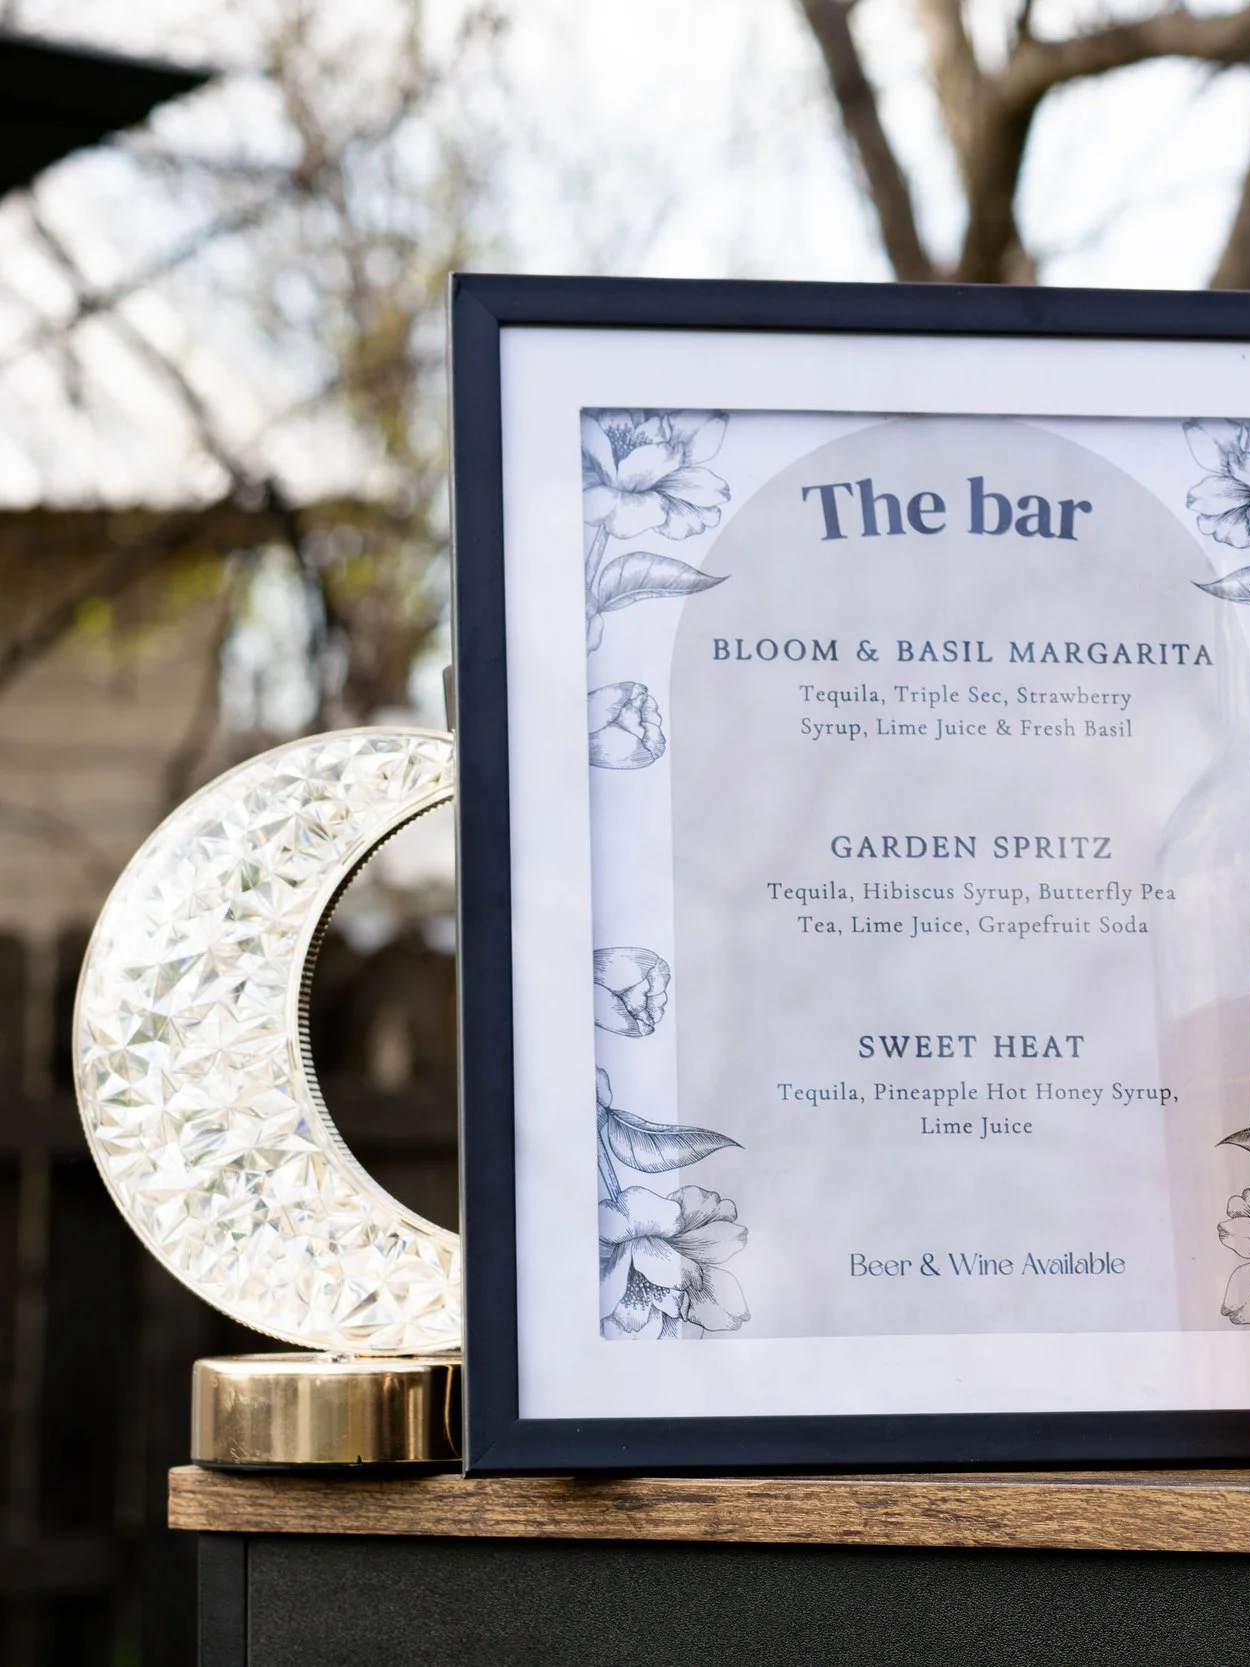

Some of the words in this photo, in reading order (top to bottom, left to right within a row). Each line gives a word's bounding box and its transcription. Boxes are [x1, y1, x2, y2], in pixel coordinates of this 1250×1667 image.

[802, 478, 946, 541] The
[967, 476, 1092, 541] bar
[713, 639, 838, 661] BLOOM
[857, 640, 879, 662] &
[897, 640, 993, 662] BASIL
[1009, 641, 1213, 665] MARGARITA
[800, 684, 885, 708] Tequila,
[894, 685, 959, 709] Triple
[969, 686, 1008, 706] Sec,
[1017, 686, 1131, 711] Strawberry
[802, 718, 867, 741] Syrup,
[877, 718, 927, 735] Lime
[935, 719, 986, 740] Juice
[996, 719, 1012, 735] &
[1021, 718, 1074, 736] Fresh
[1085, 719, 1131, 736] Basil
[831, 836, 976, 858] GARDEN
[994, 836, 1111, 859] SPRITZ
[767, 881, 854, 906] Tequila,
[864, 881, 954, 899] Hibiscus
[964, 883, 1029, 906] Syrup,
[1040, 881, 1132, 906] Butterfly
[1141, 884, 1176, 900] Pea
[798, 916, 842, 935] Tea,
[851, 916, 902, 932] Lime
[910, 916, 969, 938] Juice,
[979, 914, 1090, 939] Grapefruit
[1100, 915, 1148, 933] Soda
[859, 1035, 976, 1058] SWEET
[993, 1035, 1084, 1058] HEAT
[778, 1082, 864, 1107] Tequila,
[874, 1081, 977, 1106] Pineapple
[987, 1083, 1026, 1100] Hot
[1036, 1083, 1103, 1106] Honey
[1112, 1083, 1178, 1106] Syrup,
[921, 1117, 972, 1134] Lime
[980, 1117, 1032, 1139] Juice
[851, 1253, 912, 1276] Beer
[920, 1253, 941, 1276] &
[948, 1253, 1013, 1275] Wine
[1022, 1252, 1125, 1275] Available
